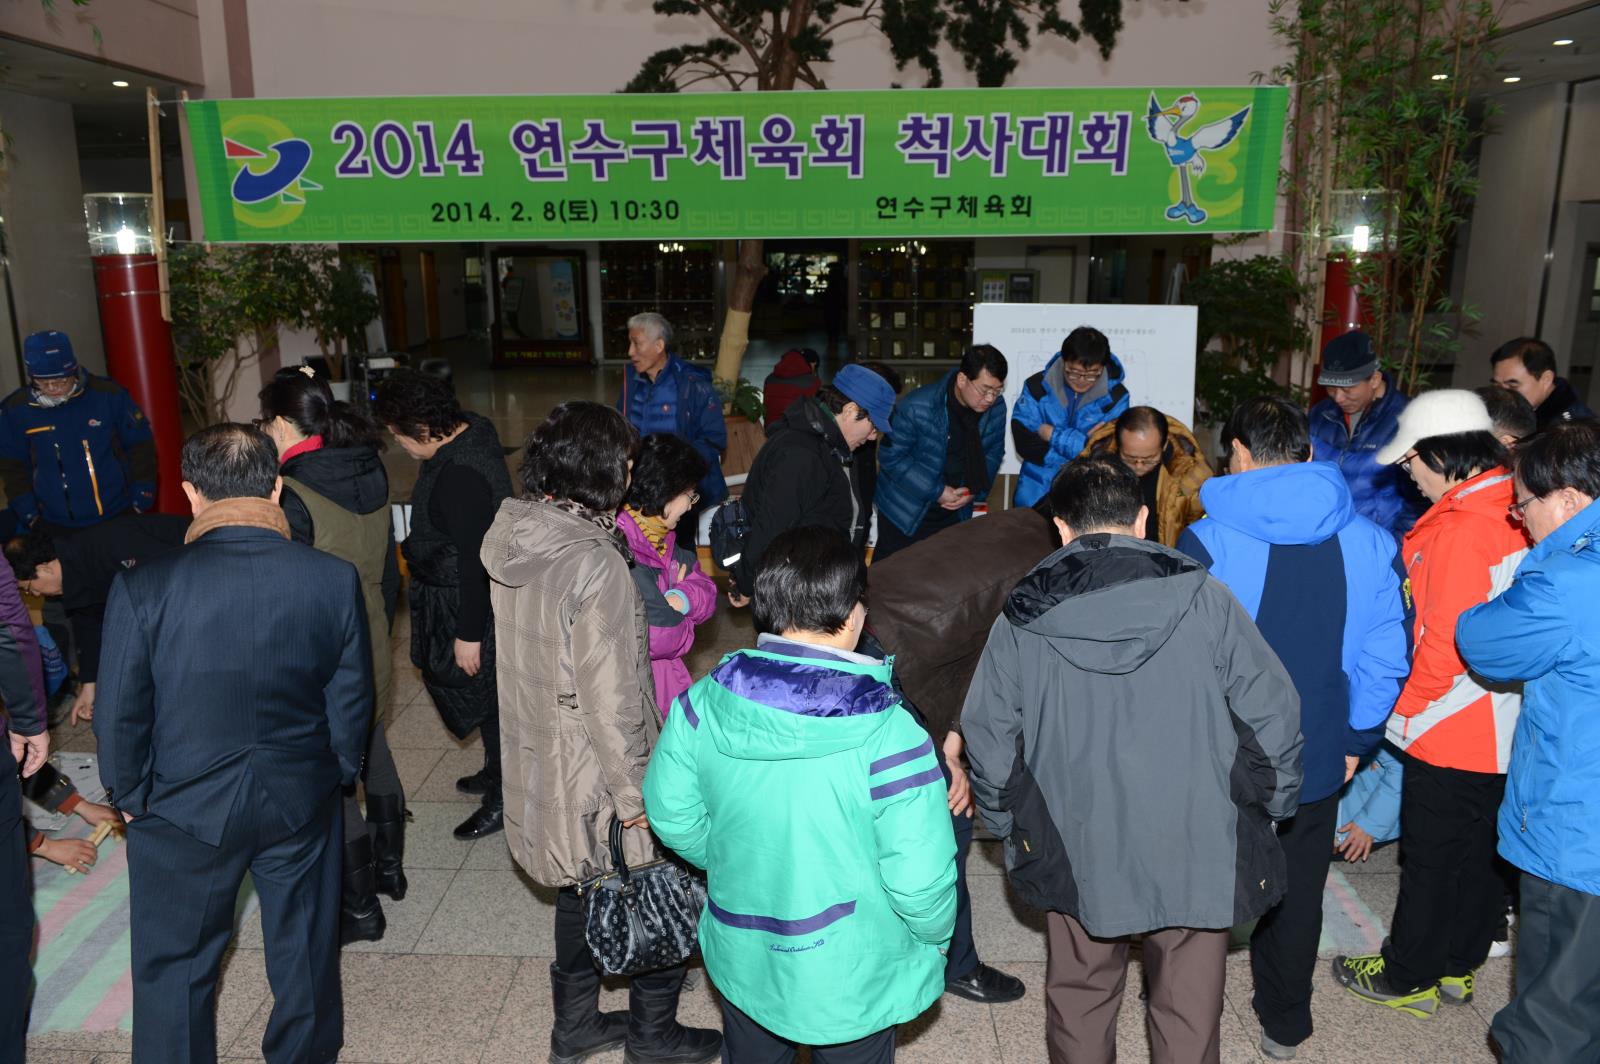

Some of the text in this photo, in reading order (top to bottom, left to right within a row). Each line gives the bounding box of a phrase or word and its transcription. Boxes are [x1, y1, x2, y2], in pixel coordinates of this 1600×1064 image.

[332, 111, 1132, 181] 2014 연수구체육회 척사대회
[431, 200, 679, 223] 2014. 2. 8(토) 10:30
[876, 195, 1033, 219] 연수구체육회
